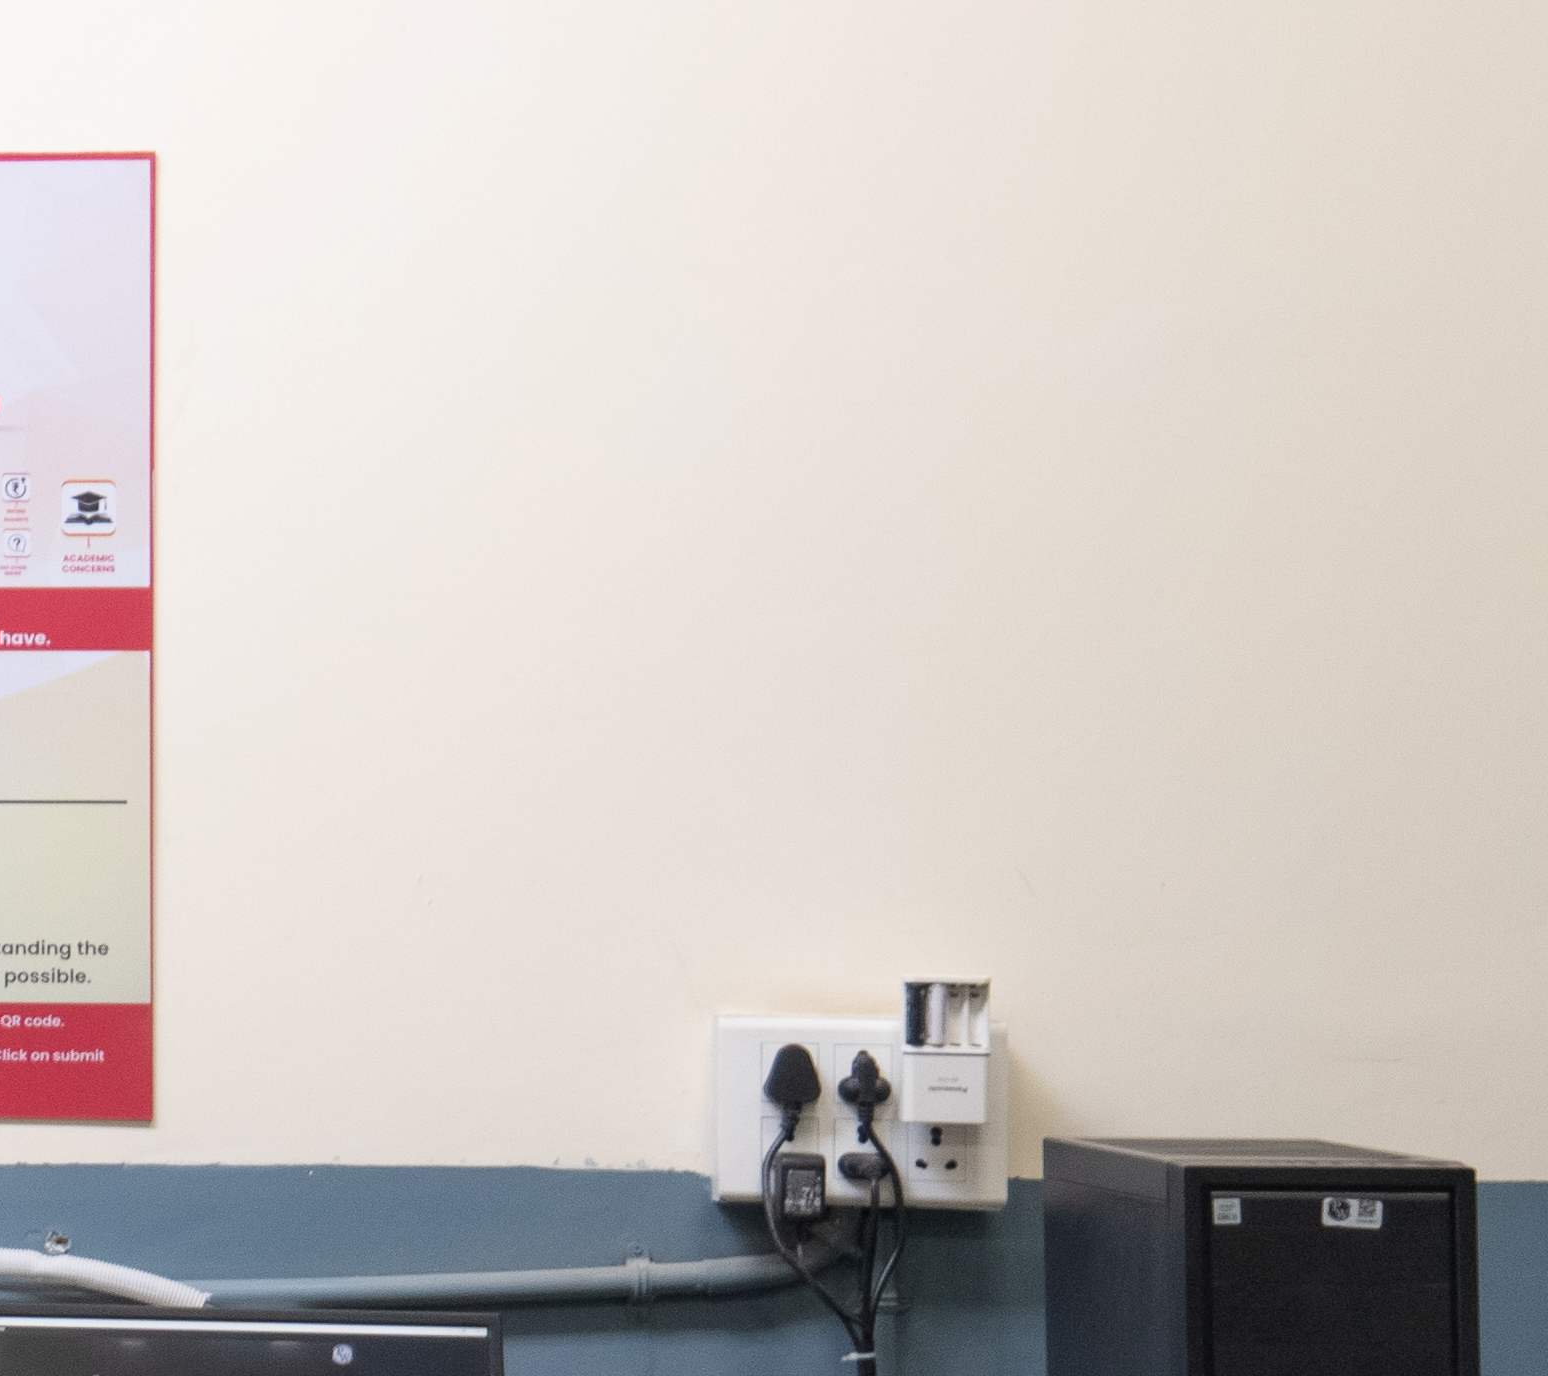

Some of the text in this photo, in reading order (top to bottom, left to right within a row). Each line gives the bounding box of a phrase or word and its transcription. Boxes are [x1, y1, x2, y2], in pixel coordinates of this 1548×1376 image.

[0, 630, 50, 646] have.
[78, 941, 108, 955] the
[4, 968, 90, 988] possible.
[31, 1052, 50, 1062] on
[53, 1049, 104, 1063] submit
